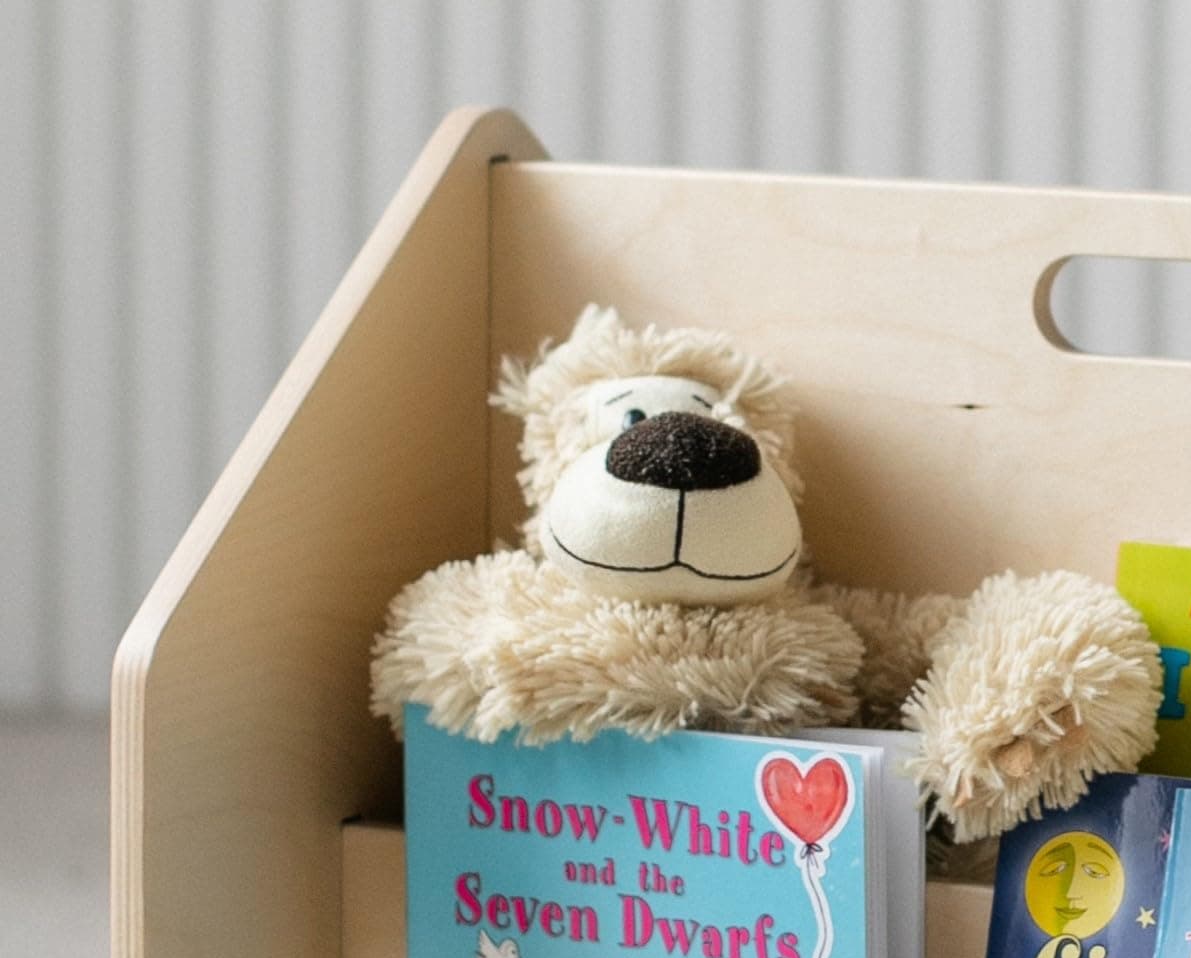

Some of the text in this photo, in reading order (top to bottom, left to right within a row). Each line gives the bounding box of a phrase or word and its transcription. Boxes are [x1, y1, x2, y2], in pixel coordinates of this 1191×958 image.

[1157, 647, 1191, 720] I
[467, 774, 787, 868] Snow-White
[454, 871, 600, 944] Seven
[564, 856, 685, 896] and the
